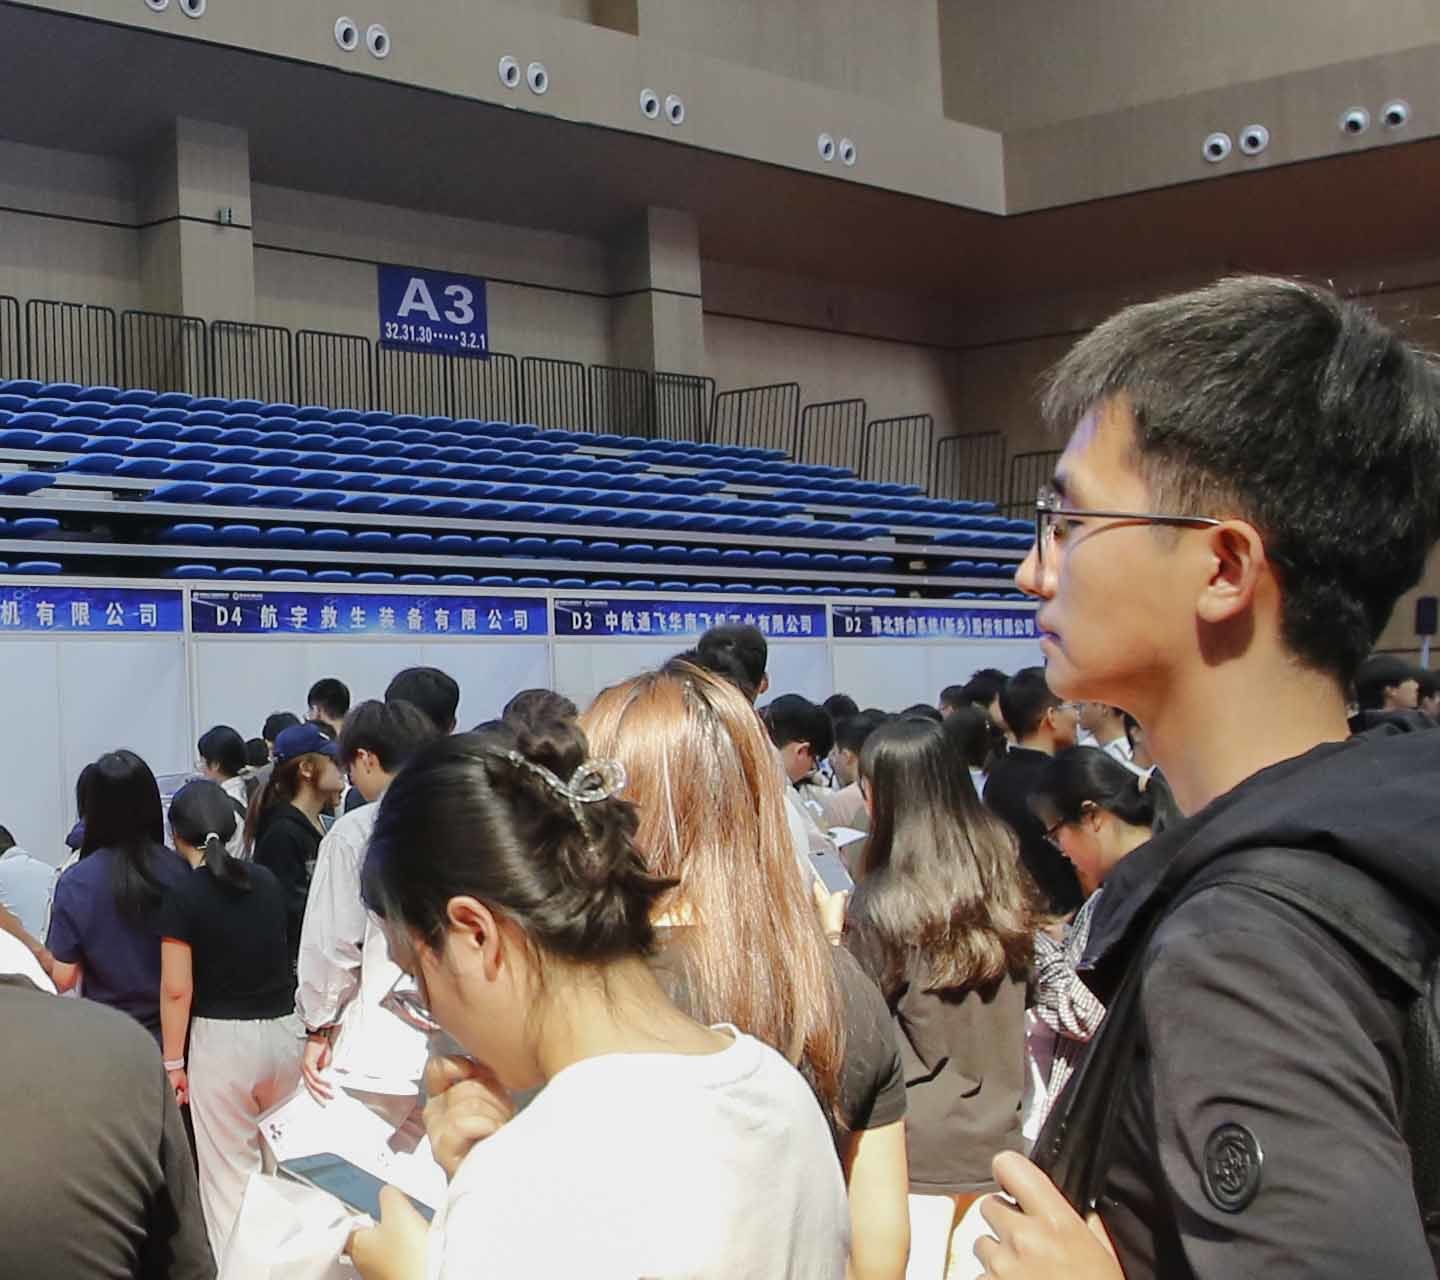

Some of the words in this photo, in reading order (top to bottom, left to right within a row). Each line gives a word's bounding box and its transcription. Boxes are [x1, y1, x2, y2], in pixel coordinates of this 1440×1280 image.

[397, 278, 475, 325] A3
[216, 606, 242, 627] D4
[260, 606, 529, 631] 航宇救生装备有限公司
[572, 612, 593, 630] D3
[845, 616, 862, 633] D2
